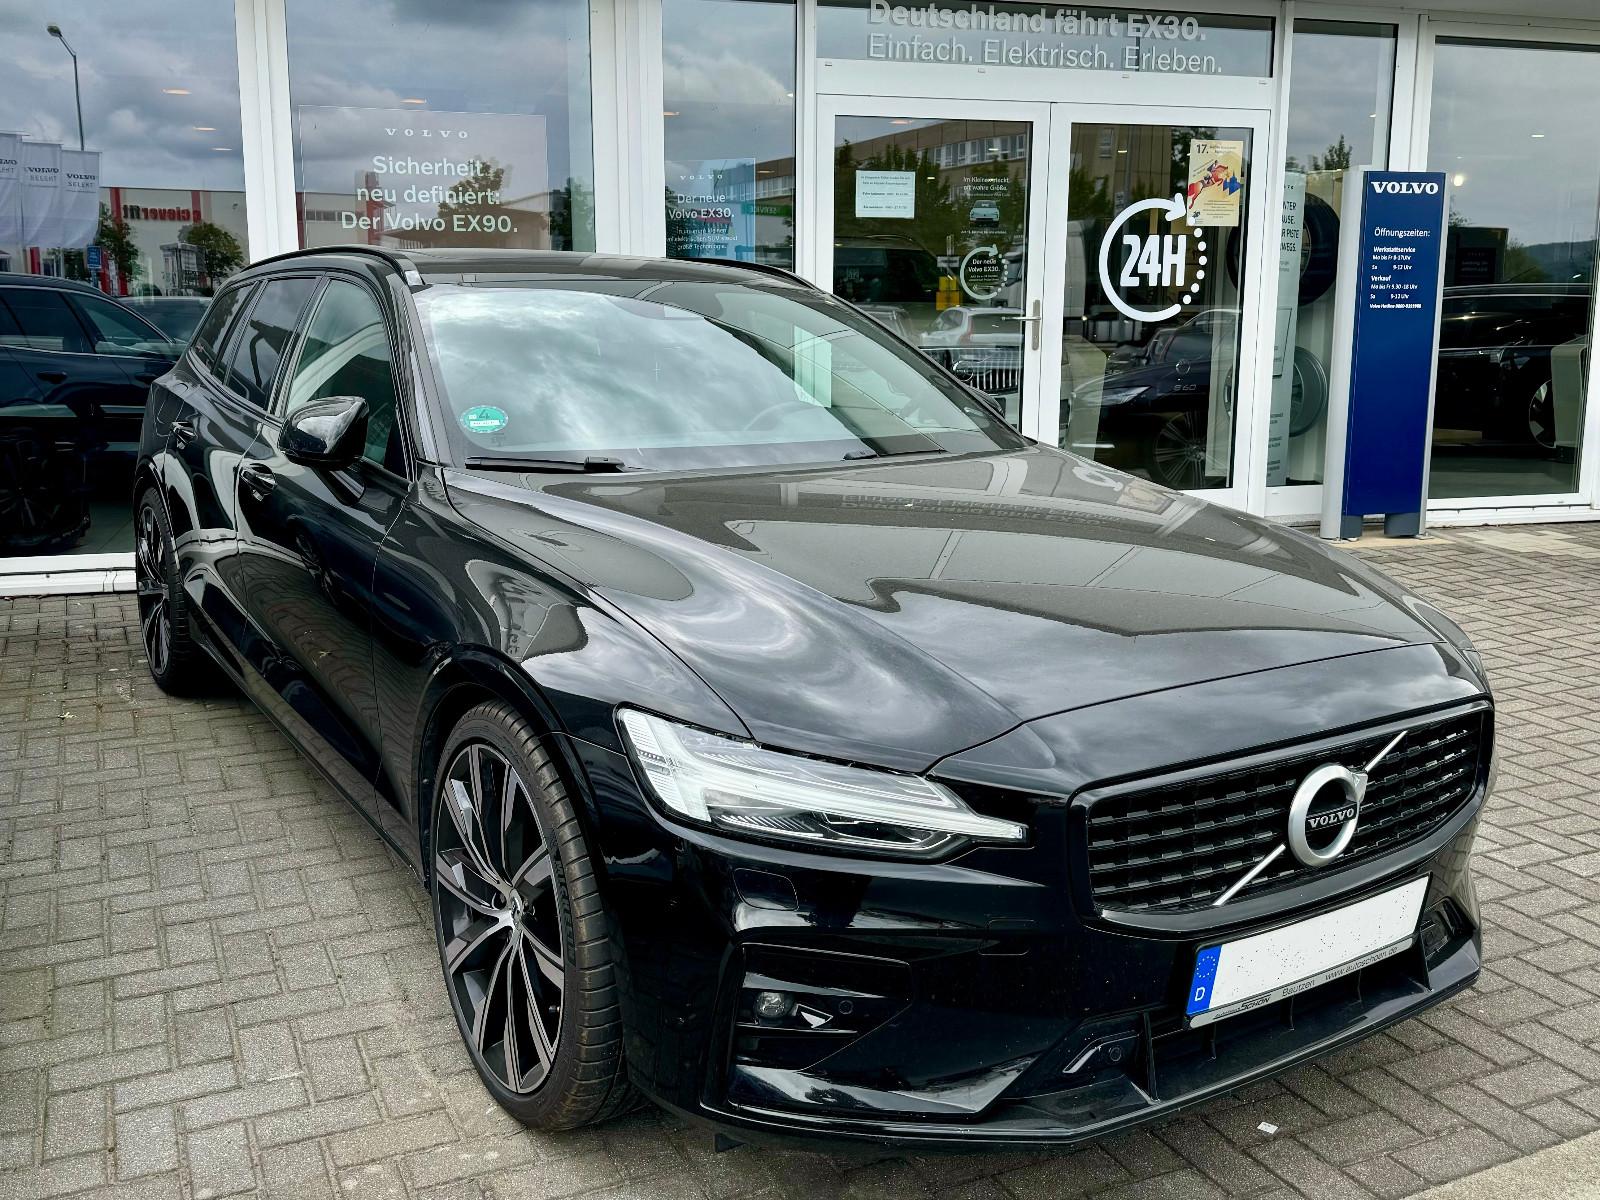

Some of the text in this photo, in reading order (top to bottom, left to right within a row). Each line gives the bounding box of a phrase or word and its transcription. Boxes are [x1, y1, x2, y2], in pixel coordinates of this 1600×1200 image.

[870, 0, 1206, 40] Deutschland fährt EX30.
[869, 32, 1222, 73] Einfach. Elektrisch. Erleben.
[385, 128, 468, 138] VOLVO
[1197, 144, 1209, 154] 17.
[357, 185, 500, 205] neu definiert:
[1371, 181, 1439, 194] VOLVO
[677, 194, 726, 203] Der neue
[668, 207, 735, 219] Volvo EX30.
[341, 211, 518, 233] Der Volvo EX90.
[1374, 227, 1431, 239] Öffnungszeiten:
[1120, 234, 1187, 287] 24H
[1307, 808, 1355, 828] VOLVO
[1194, 987, 1206, 1002] D
